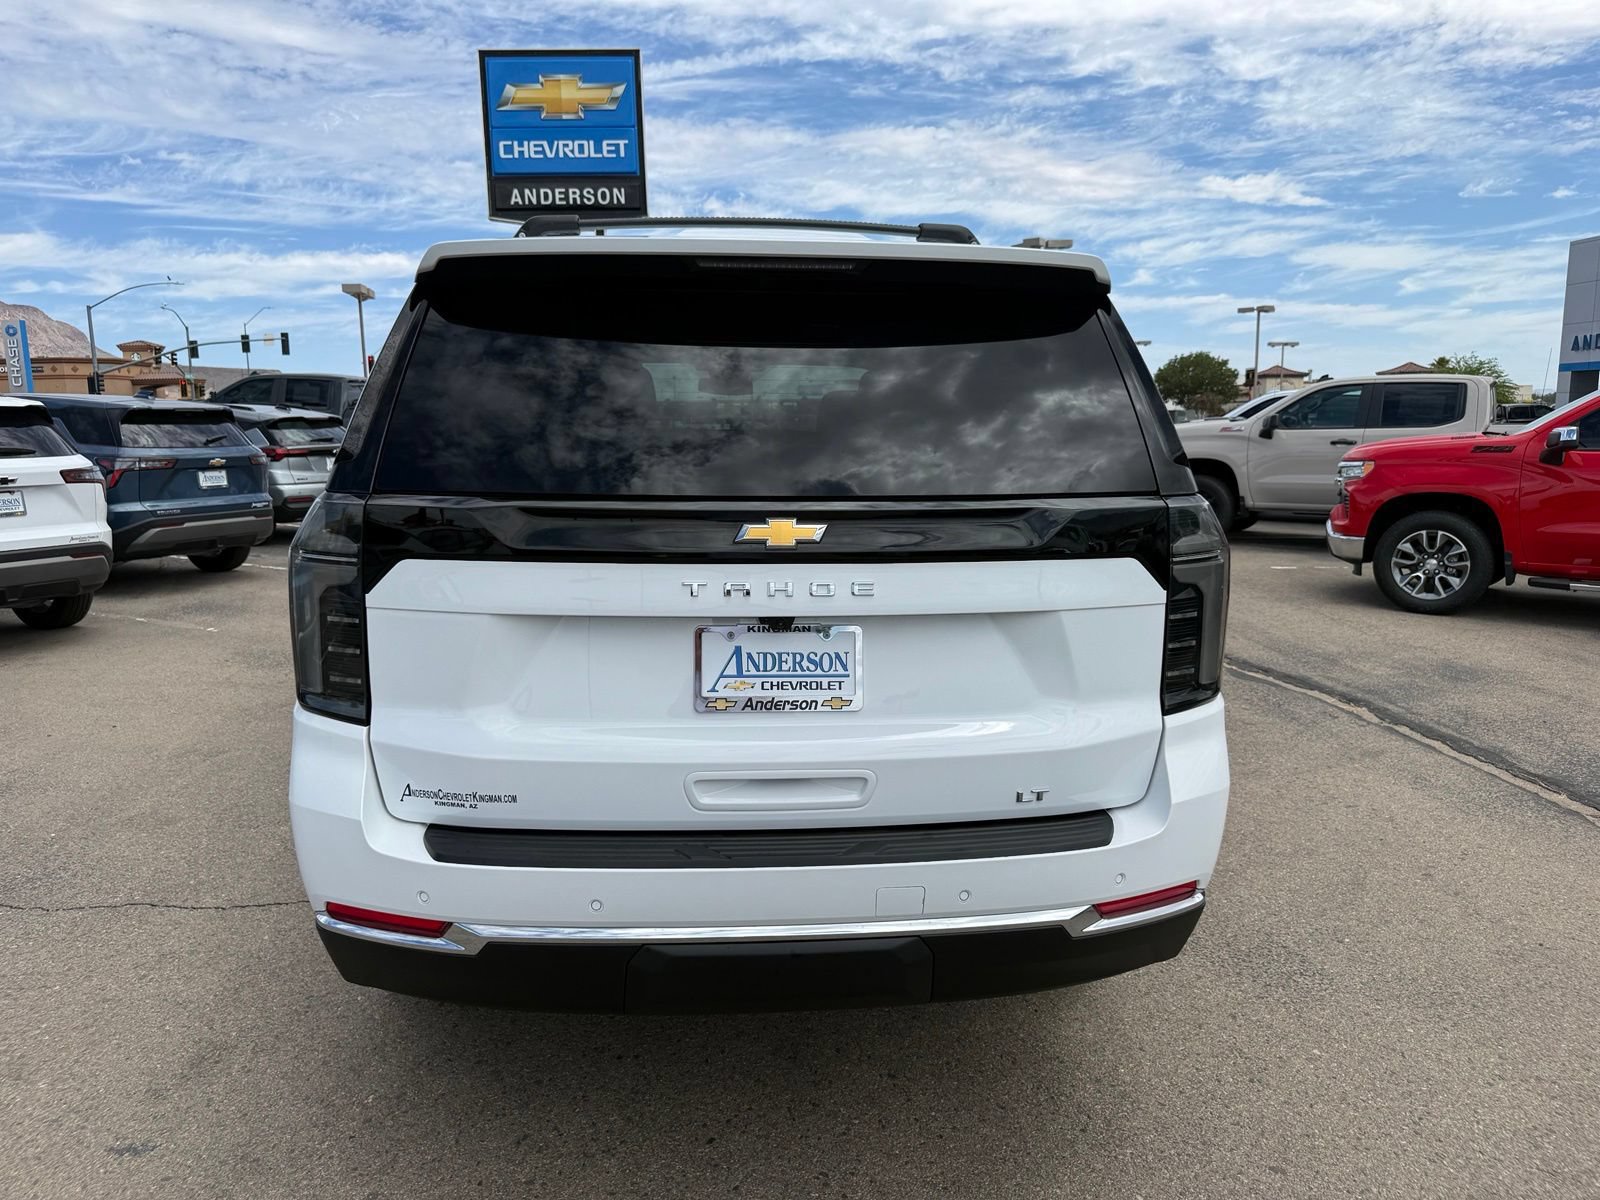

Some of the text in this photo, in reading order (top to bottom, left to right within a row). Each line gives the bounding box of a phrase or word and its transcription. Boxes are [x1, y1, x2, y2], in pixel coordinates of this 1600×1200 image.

[499, 139, 628, 159] CHEVROLET
[510, 187, 626, 206] ANDERSON
[7, 339, 22, 387] CHASE
[682, 581, 875, 598] TAHOE
[706, 645, 850, 693] ANDERSON
[760, 680, 845, 691] CHEVROLET
[741, 696, 818, 711] Anderson
[434, 800, 467, 809] KINGMAN,
[1016, 789, 1050, 803] LT
